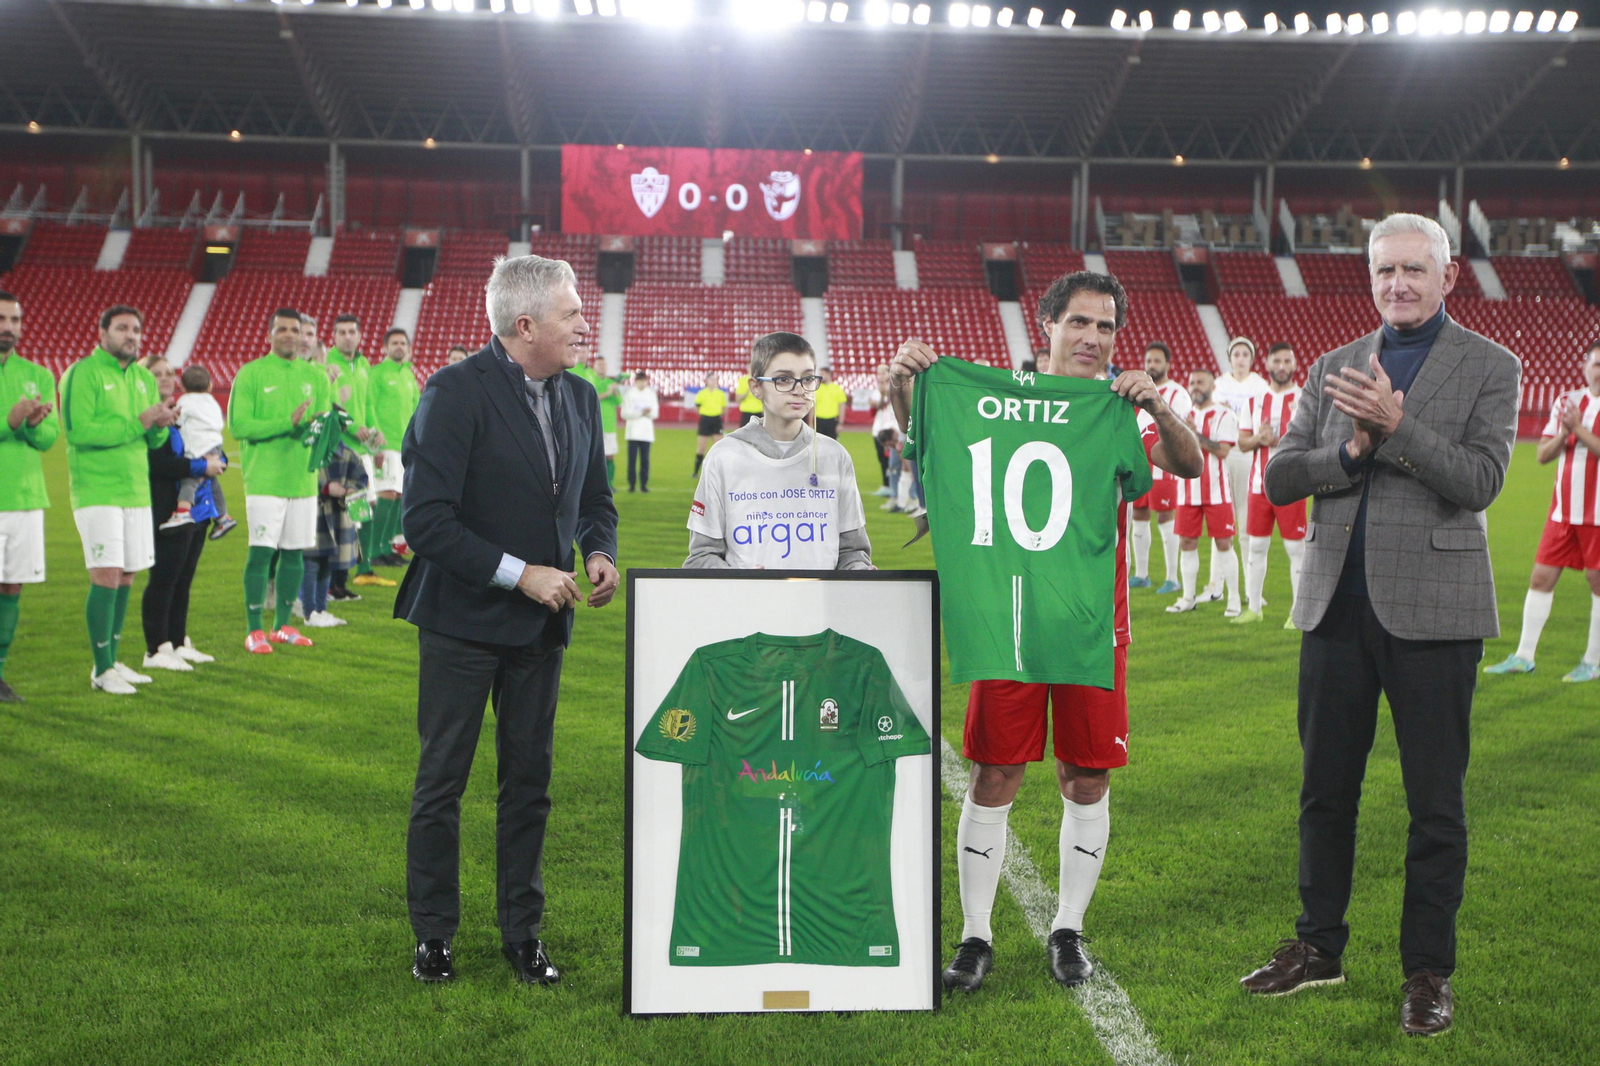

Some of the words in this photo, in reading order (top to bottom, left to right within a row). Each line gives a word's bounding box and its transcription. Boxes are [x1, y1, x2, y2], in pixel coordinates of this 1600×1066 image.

[678, 182, 701, 211] 0
[725, 183, 748, 212] 0
[977, 395, 1070, 424] ORTIZ
[728, 491, 758, 502] Todos
[760, 491, 778, 499] con
[780, 487, 806, 499] JOSÉ
[808, 489, 835, 499] ORTIZ
[967, 436, 1073, 552] 10
[776, 511, 795, 519] con
[797, 509, 829, 519] cáncer
[732, 522, 828, 559] argar
[737, 757, 837, 784] Andalucía
